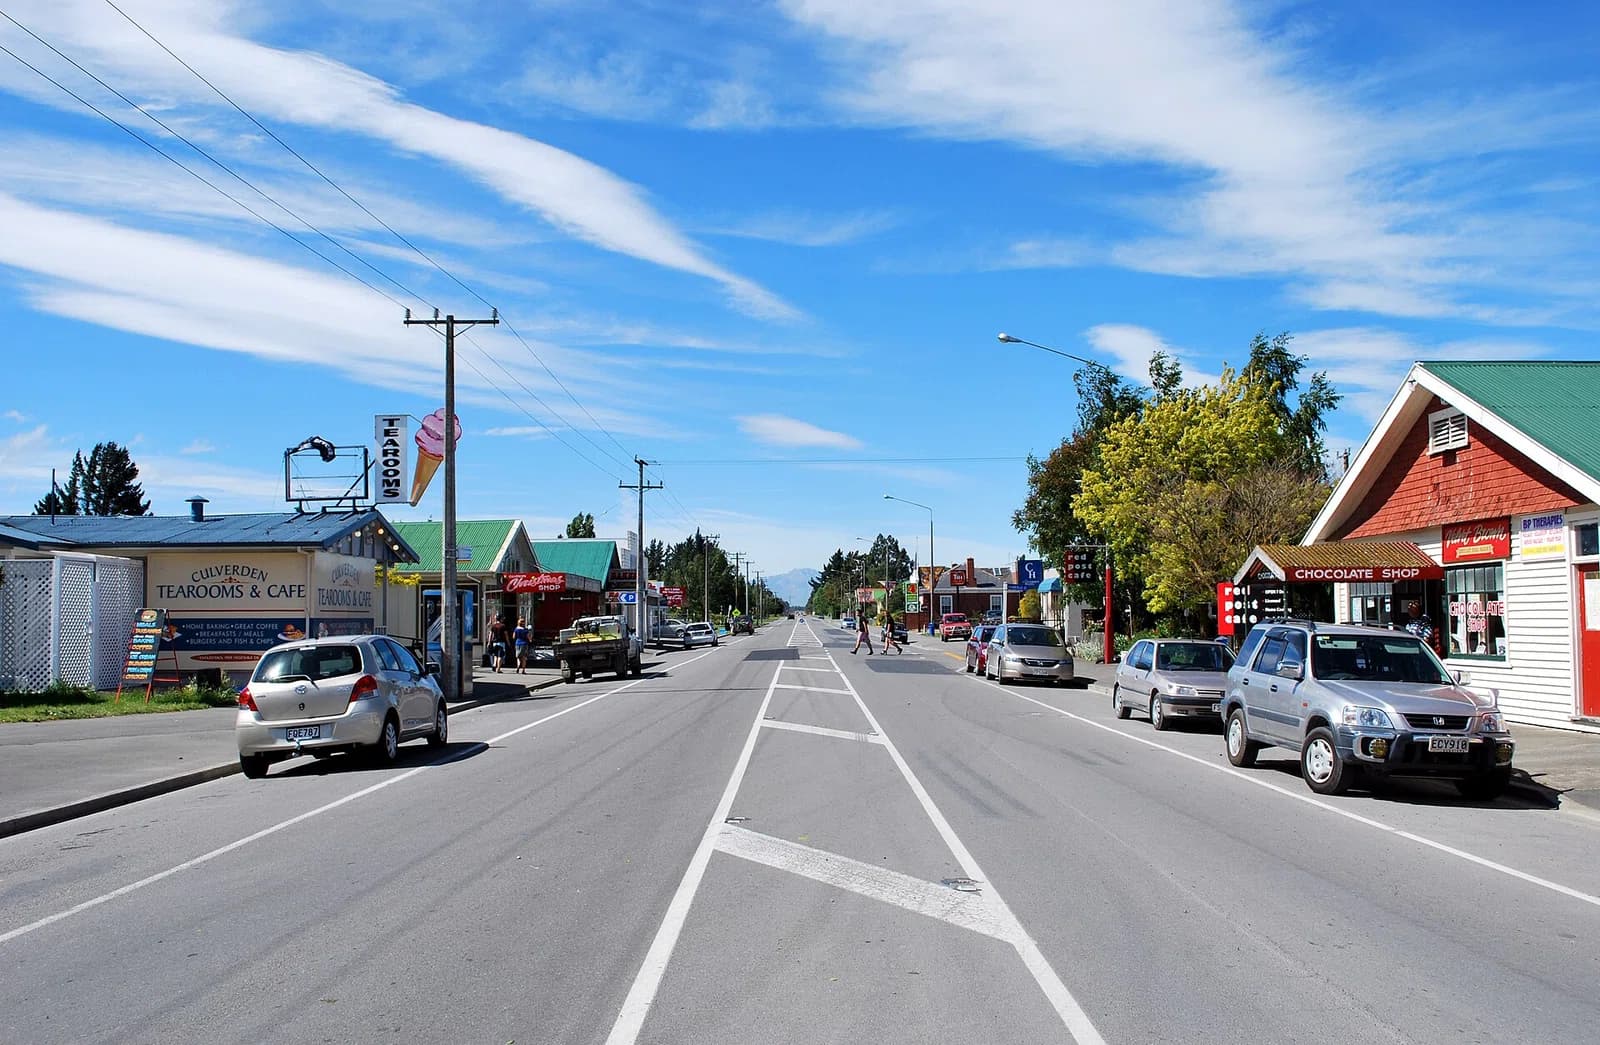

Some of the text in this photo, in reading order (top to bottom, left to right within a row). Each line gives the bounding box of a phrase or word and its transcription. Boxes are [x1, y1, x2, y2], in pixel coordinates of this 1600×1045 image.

[382, 417, 401, 498] TEAROOMS
[1522, 514, 1563, 529] BP THERAPIES
[191, 564, 268, 583] CULVERDEN
[1294, 568, 1420, 579] CHOCOLATE SHOP
[156, 584, 306, 599] TEAROOMS & CAFE
[1467, 618, 1487, 632] SHOP
